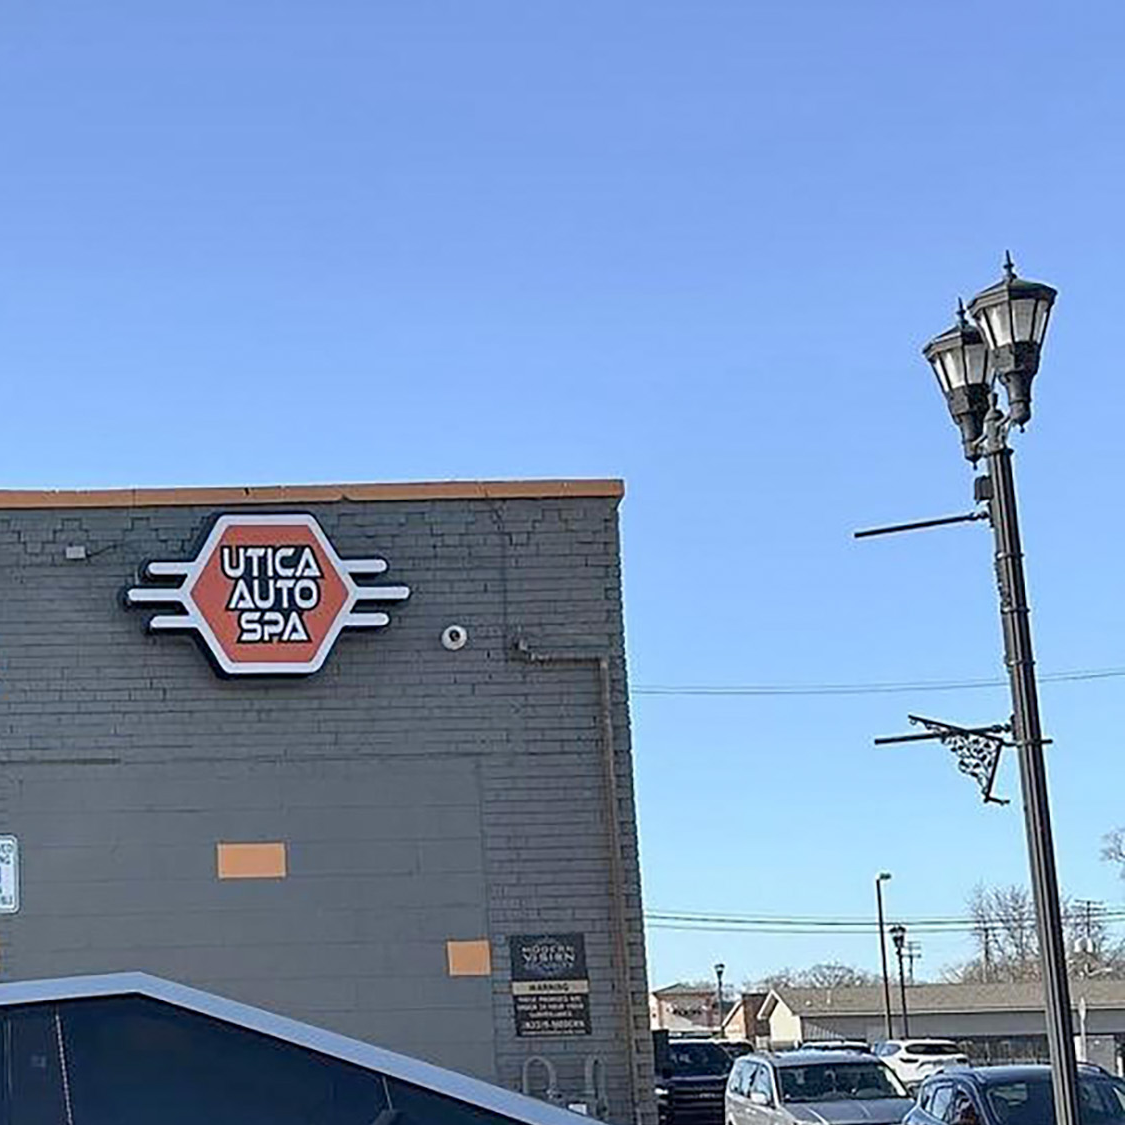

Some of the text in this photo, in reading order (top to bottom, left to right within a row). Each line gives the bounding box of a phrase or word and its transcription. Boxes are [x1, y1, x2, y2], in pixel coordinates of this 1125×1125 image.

[222, 547, 322, 577] UTICA
[229, 578, 318, 609] AUTO
[240, 611, 309, 641] SPA
[528, 982, 569, 991] WARNING
